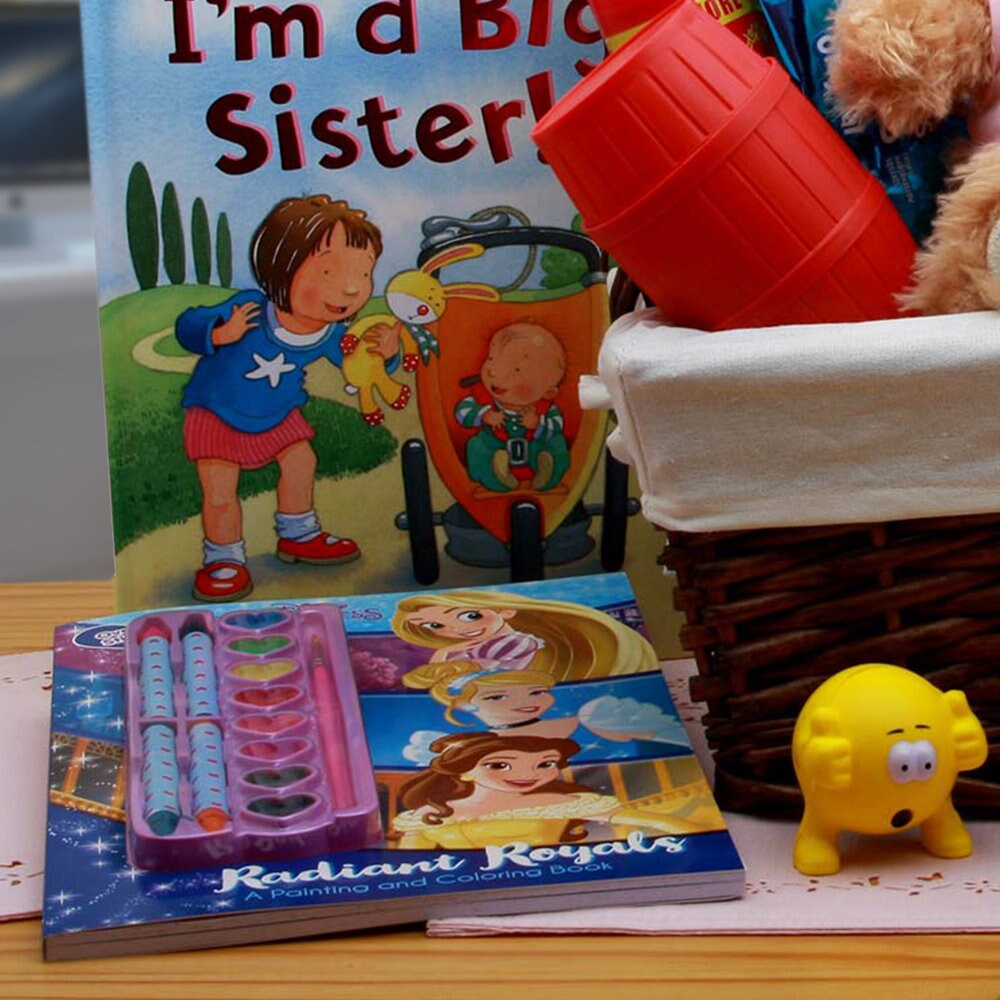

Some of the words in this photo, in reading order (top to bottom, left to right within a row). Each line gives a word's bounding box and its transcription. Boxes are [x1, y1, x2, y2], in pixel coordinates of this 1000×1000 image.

[213, 852, 467, 894] Radiant
[479, 831, 687, 871] Royals
[244, 890, 262, 901] A
[271, 882, 369, 900] Painting
[378, 876, 428, 891] and
[435, 867, 542, 888] Coloring
[550, 860, 613, 875] Book
